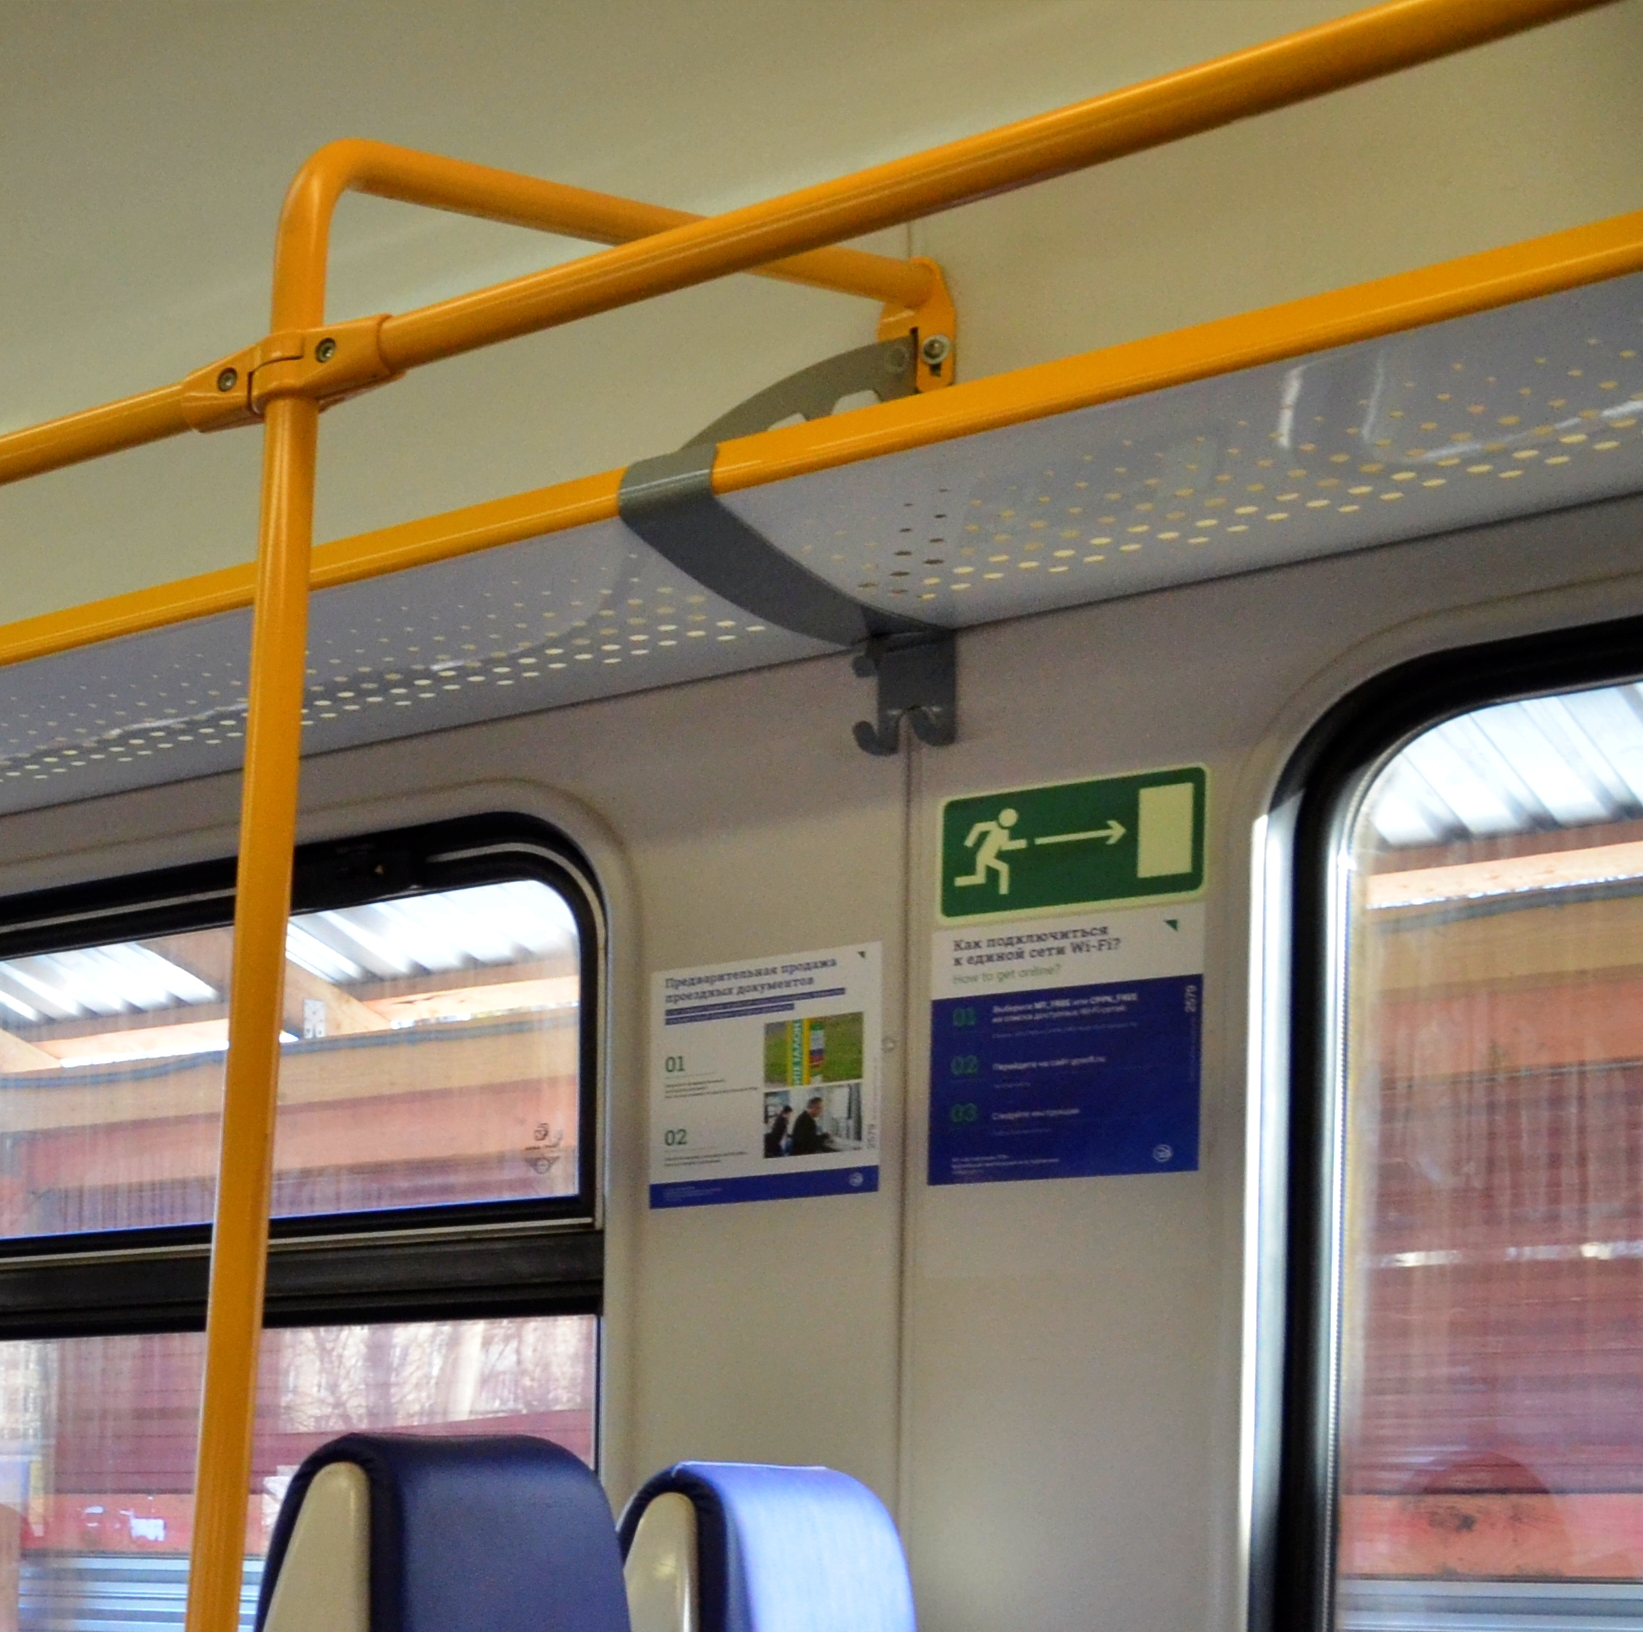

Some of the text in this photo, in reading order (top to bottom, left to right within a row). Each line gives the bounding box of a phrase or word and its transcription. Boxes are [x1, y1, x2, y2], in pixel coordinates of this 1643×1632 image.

[953, 925, 1109, 951] Как подключиться
[953, 938, 1122, 966] к единой сети Wi-Fi?
[664, 959, 838, 990] Предварительная продажа
[665, 986, 734, 1004] проездных
[736, 977, 814, 994] документов
[665, 1056, 685, 1073] 01
[664, 1129, 688, 1146] 02
